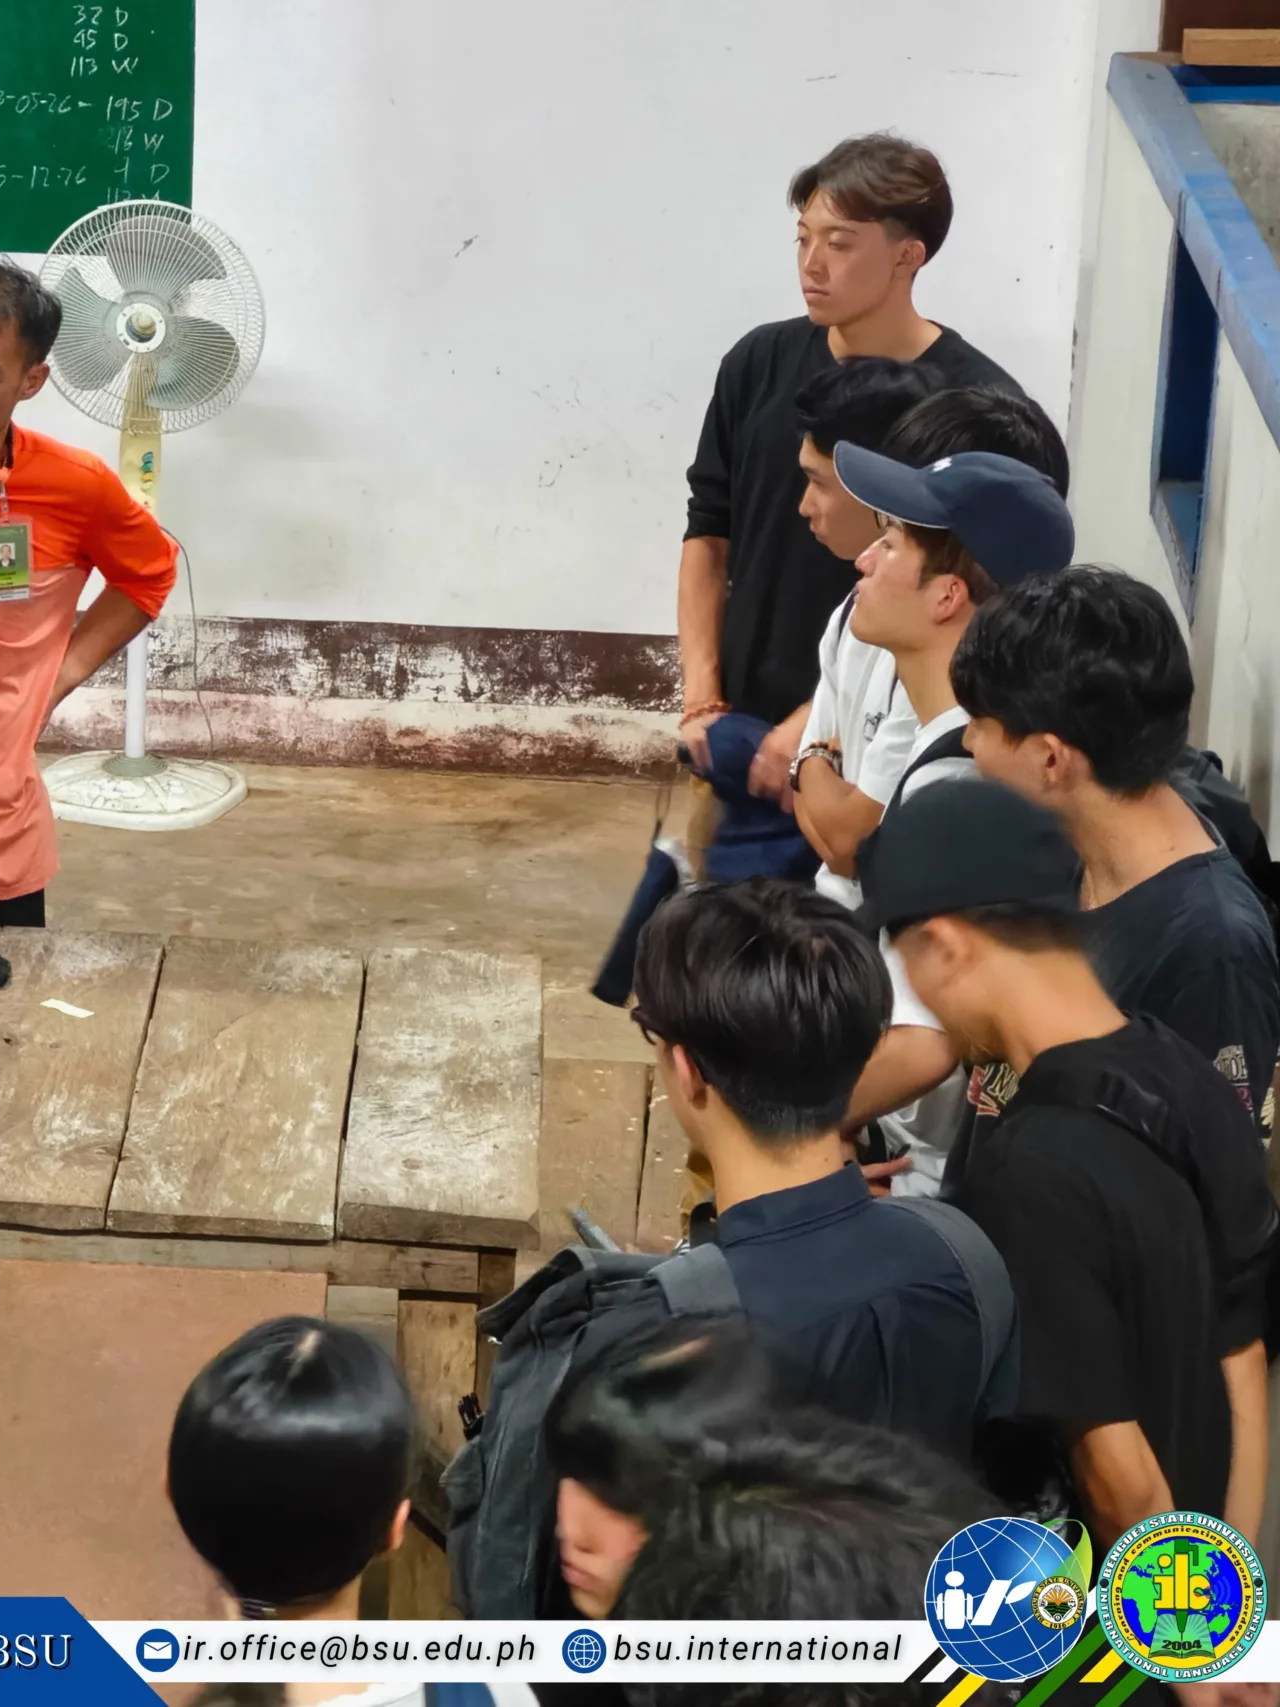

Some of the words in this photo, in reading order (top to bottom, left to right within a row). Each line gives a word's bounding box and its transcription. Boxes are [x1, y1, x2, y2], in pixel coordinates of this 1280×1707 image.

[115, 6, 129, 27] D
[113, 32, 129, 51] D
[70, 56, 98, 77] 113
[112, 57, 139, 75] W
[152, 97, 173, 121] D
[150, 164, 170, 184] D
